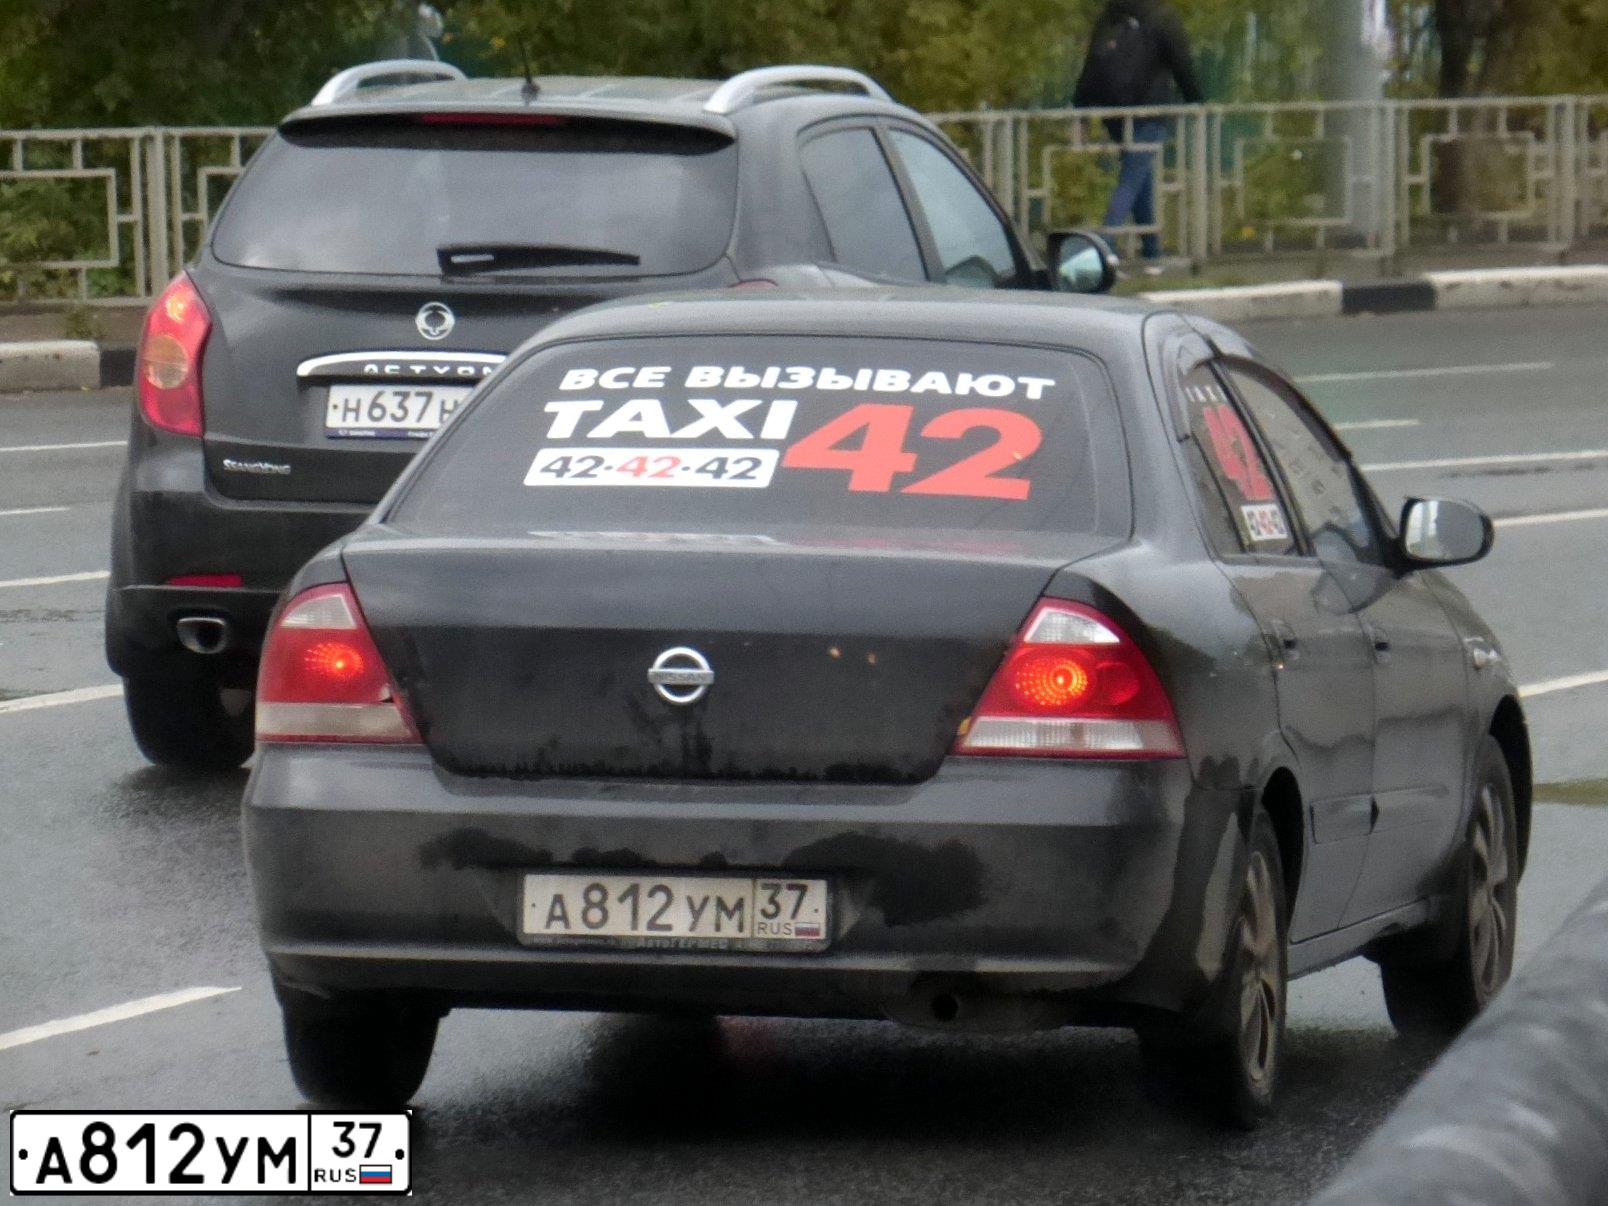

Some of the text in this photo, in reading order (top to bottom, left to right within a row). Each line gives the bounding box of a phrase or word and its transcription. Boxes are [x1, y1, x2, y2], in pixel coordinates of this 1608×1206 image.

[558, 366, 1056, 399] ВСЕ ВЫЗЫВАЮТ
[543, 399, 798, 439] TAXI
[783, 403, 1043, 500] 42
[760, 882, 808, 920] 37
[757, 921, 792, 936] RUS
